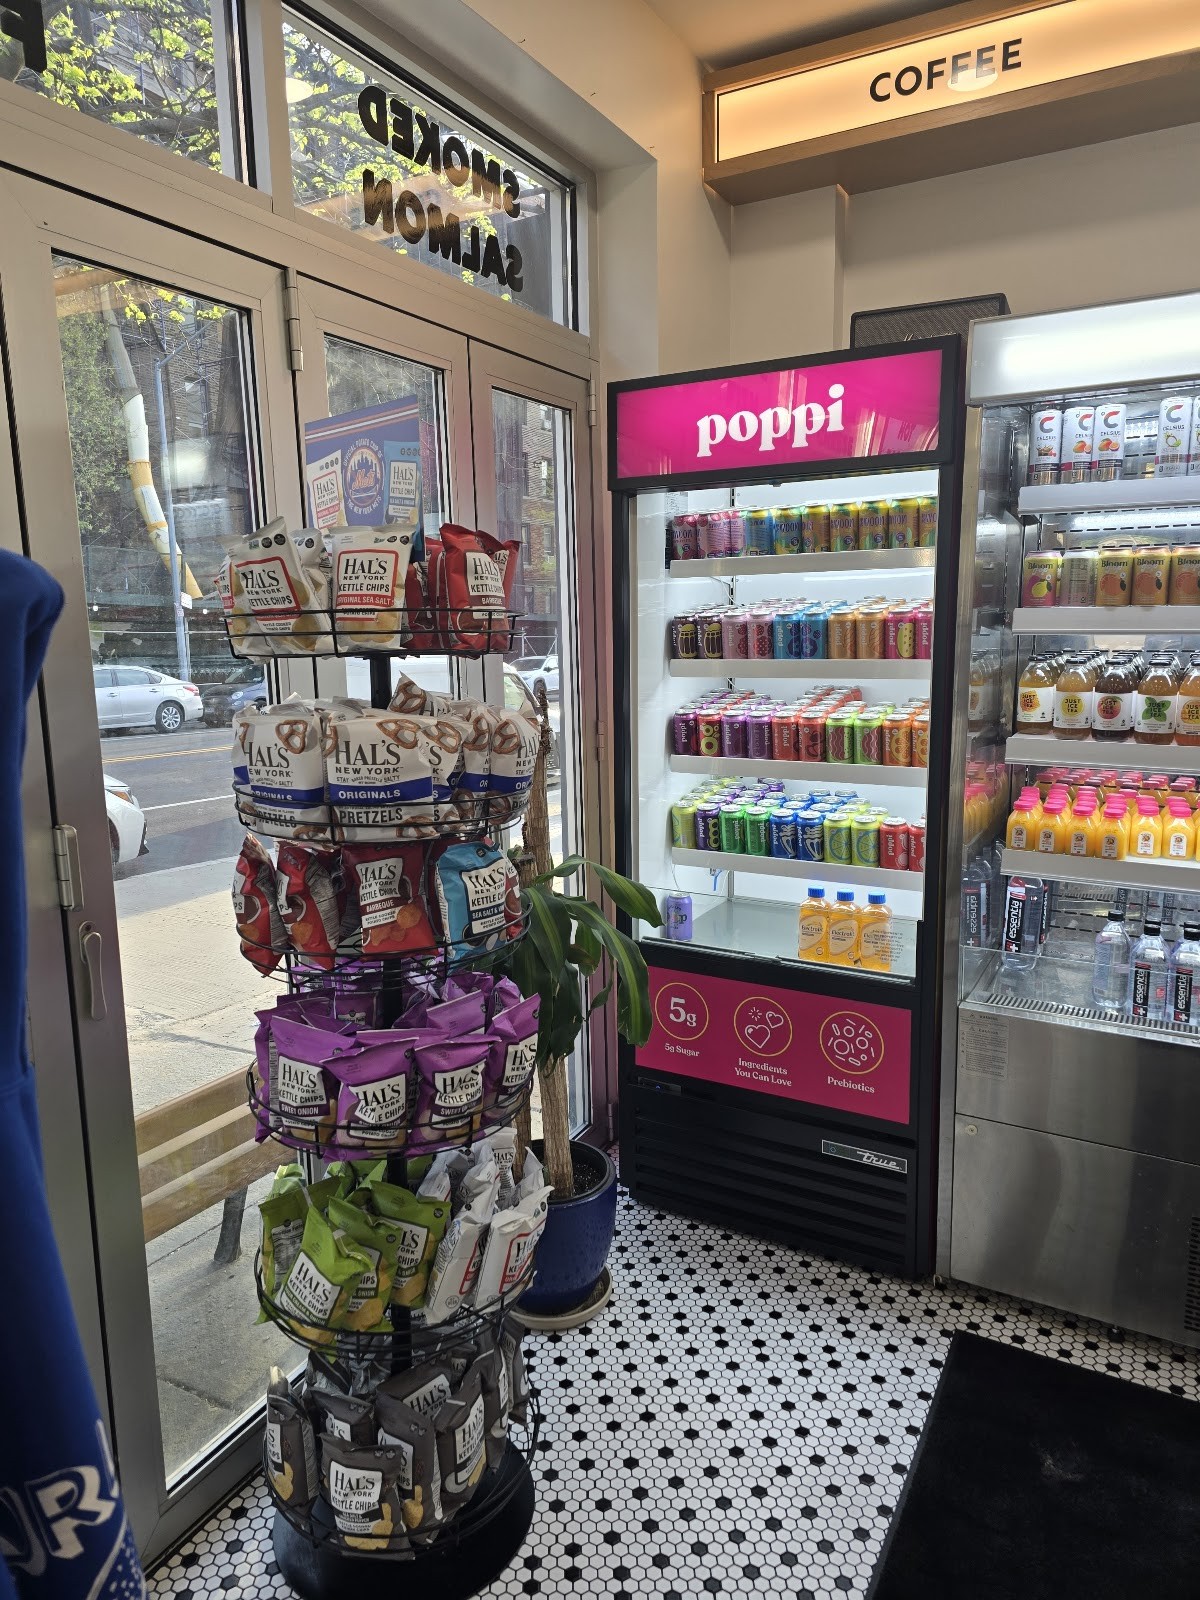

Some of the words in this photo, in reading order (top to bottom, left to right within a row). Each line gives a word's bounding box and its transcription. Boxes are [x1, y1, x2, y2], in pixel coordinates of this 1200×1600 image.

[869, 37, 1023, 102] COFFEE
[696, 384, 845, 457] poppi
[394, 466, 414, 480] HAL'S
[316, 478, 335, 496] HAL'S
[344, 558, 387, 575] HAL'S
[1028, 562, 1053, 570] Bloom
[1136, 558, 1165, 566] Bloom
[241, 569, 280, 589] HAL'S
[366, 584, 390, 593] CHIPS
[270, 596, 293, 605] CHIPS
[362, 596, 374, 604] SEA
[376, 597, 391, 606] SALT
[921, 622, 929, 645] poppi
[680, 723, 688, 743] poppi
[782, 726, 790, 747] poppi
[244, 742, 290, 768] HAL'S
[335, 740, 400, 766] HAL'S
[266, 770, 291, 778] YORK
[336, 767, 361, 775] NEW
[370, 767, 400, 775] YORK
[339, 790, 400, 800] ORIGINALS
[339, 808, 403, 824] PRETZELS
[758, 823, 766, 843] poppi
[886, 835, 895, 856] poppi
[361, 864, 397, 885] HAL'S
[468, 867, 504, 889] HAL'S
[361, 890, 377, 902] KETTLE
[379, 888, 399, 896] CHIPS
[471, 894, 497, 908] KETTLE
[366, 900, 394, 913] BARBEQUE
[472, 911, 482, 919] SEA
[483, 909, 493, 918] SALT
[1008, 900, 1020, 939] essentia
[1135, 970, 1145, 1004] essentia
[1177, 974, 1188, 1009] essentia
[669, 997, 697, 1027] 5g
[512, 1043, 537, 1066] HAL'S
[665, 1042, 675, 1054] 5g
[676, 1045, 700, 1057] Sugar
[511, 1065, 526, 1073] NEW
[738, 1058, 788, 1075] Ingredients
[282, 1063, 317, 1089] HAL'S
[443, 1066, 480, 1094] HAL'S
[734, 1067, 752, 1078] You
[752, 1071, 769, 1082] Can
[770, 1074, 792, 1087] Love
[282, 1082, 296, 1091] NEW
[298, 1086, 316, 1095] YORK
[460, 1082, 479, 1091] YORK
[828, 1076, 875, 1094] Prebiotics
[279, 1089, 298, 1104] KETTLE
[300, 1095, 325, 1103] CHIPS
[356, 1084, 401, 1107] HAL'S
[438, 1092, 464, 1104] KETTLE
[466, 1086, 482, 1102] CHIPS
[298, 1106, 319, 1115] ONION
[380, 1100, 400, 1110] YORK
[385, 1103, 405, 1120] CHIPS
[494, 1152, 514, 1161] HAL'S
[298, 1262, 331, 1302] HAL'S
[289, 1278, 308, 1303] KETTLE
[308, 1300, 328, 1316] CHIPS
[309, 1291, 325, 1307] YORK
[410, 1383, 448, 1415] HAL'S
[429, 1396, 448, 1413] YORK
[462, 1405, 483, 1443] HAL'S
[335, 1470, 375, 1492] HAL'S
[335, 1489, 349, 1497] NEW
[355, 1501, 377, 1511] CHIPS
